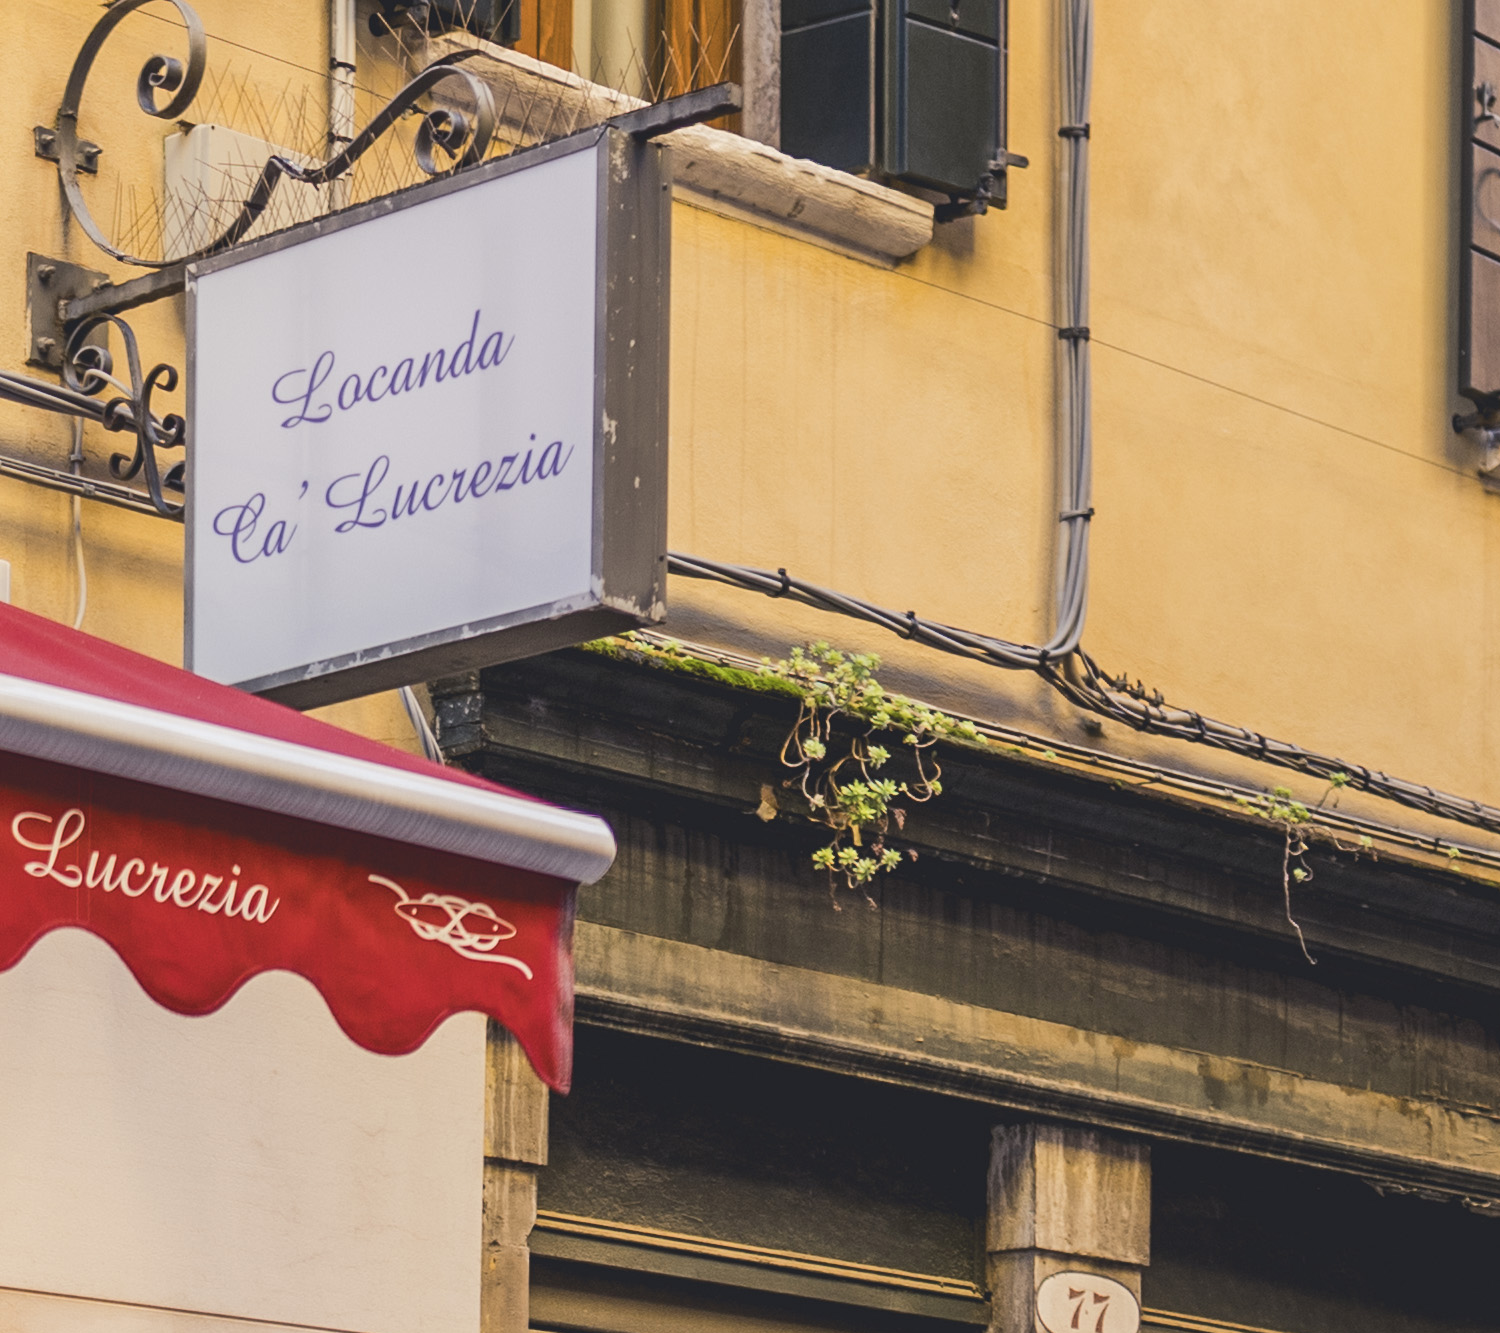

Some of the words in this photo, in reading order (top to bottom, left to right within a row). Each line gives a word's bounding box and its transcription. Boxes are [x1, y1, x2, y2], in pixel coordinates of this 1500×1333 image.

[272, 309, 515, 428] Locanda
[213, 481, 308, 563] Ca'
[326, 433, 574, 533] Lucrezia
[12, 808, 280, 923] Lucrezia
[1068, 1286, 1111, 1333] 77
